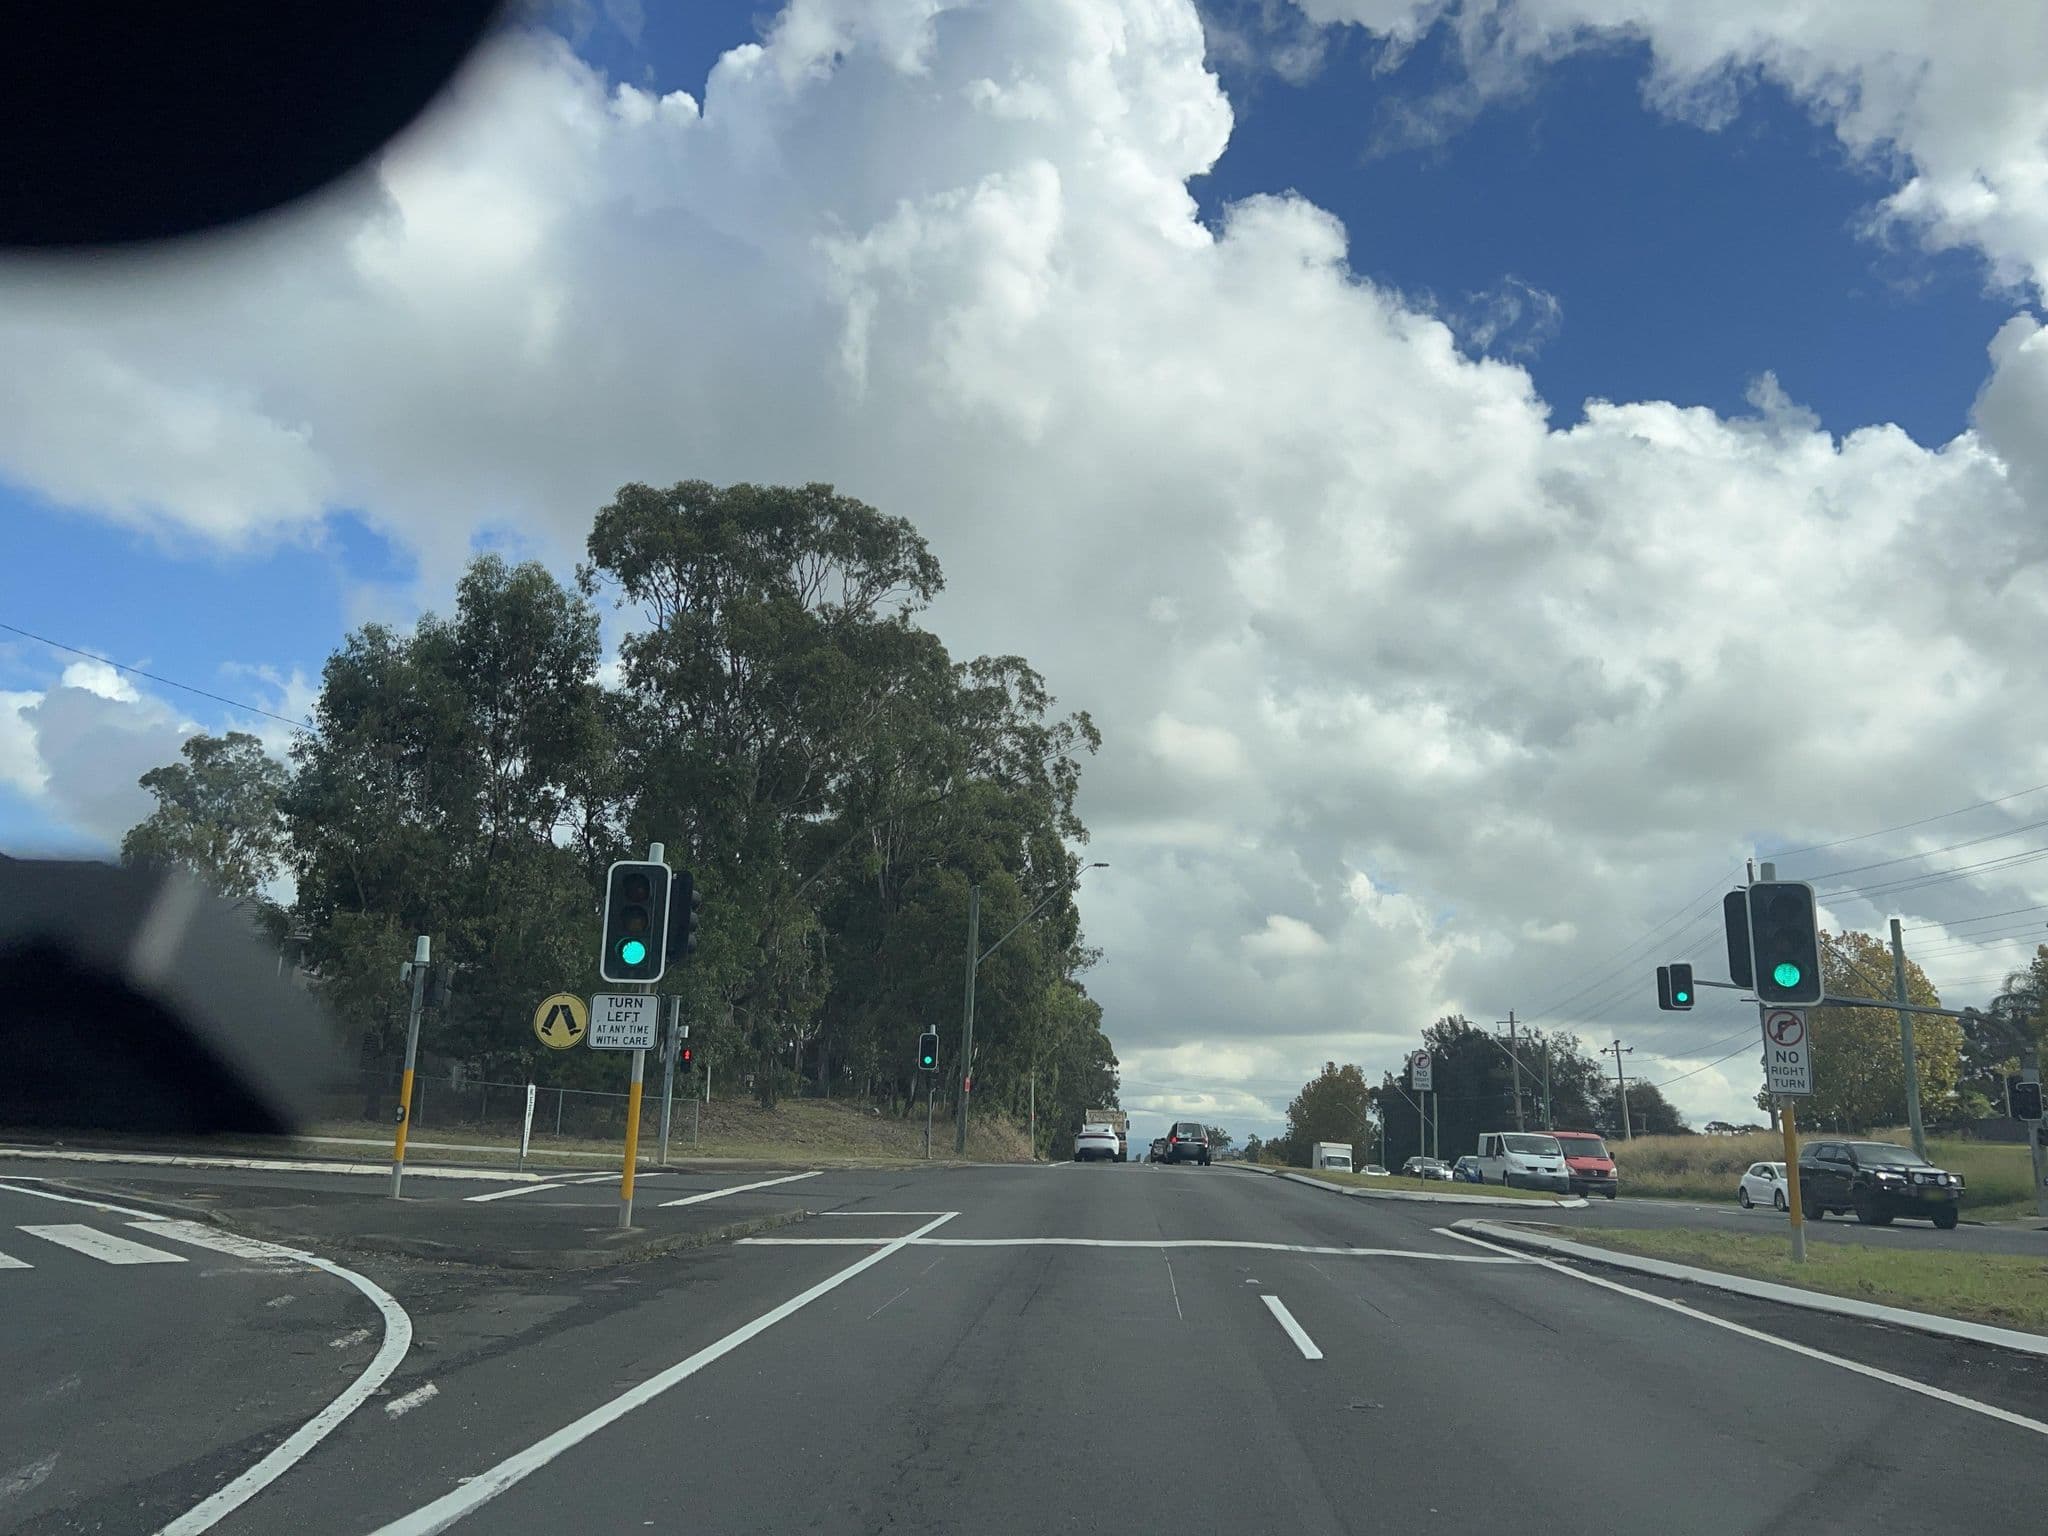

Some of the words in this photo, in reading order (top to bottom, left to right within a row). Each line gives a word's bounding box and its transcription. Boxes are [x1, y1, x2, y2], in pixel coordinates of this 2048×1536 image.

[607, 997, 643, 1008] TURN
[607, 1011, 640, 1022] LEFT
[597, 1025, 606, 1033] AT
[609, 1025, 626, 1034] ANY
[629, 1025, 649, 1034] TIME
[596, 1035, 618, 1045] WITH
[622, 1036, 648, 1046] CARE
[1775, 1050, 1799, 1064] NO
[1771, 1066, 1805, 1076] RIGHT
[1773, 1078, 1805, 1088] TURN
